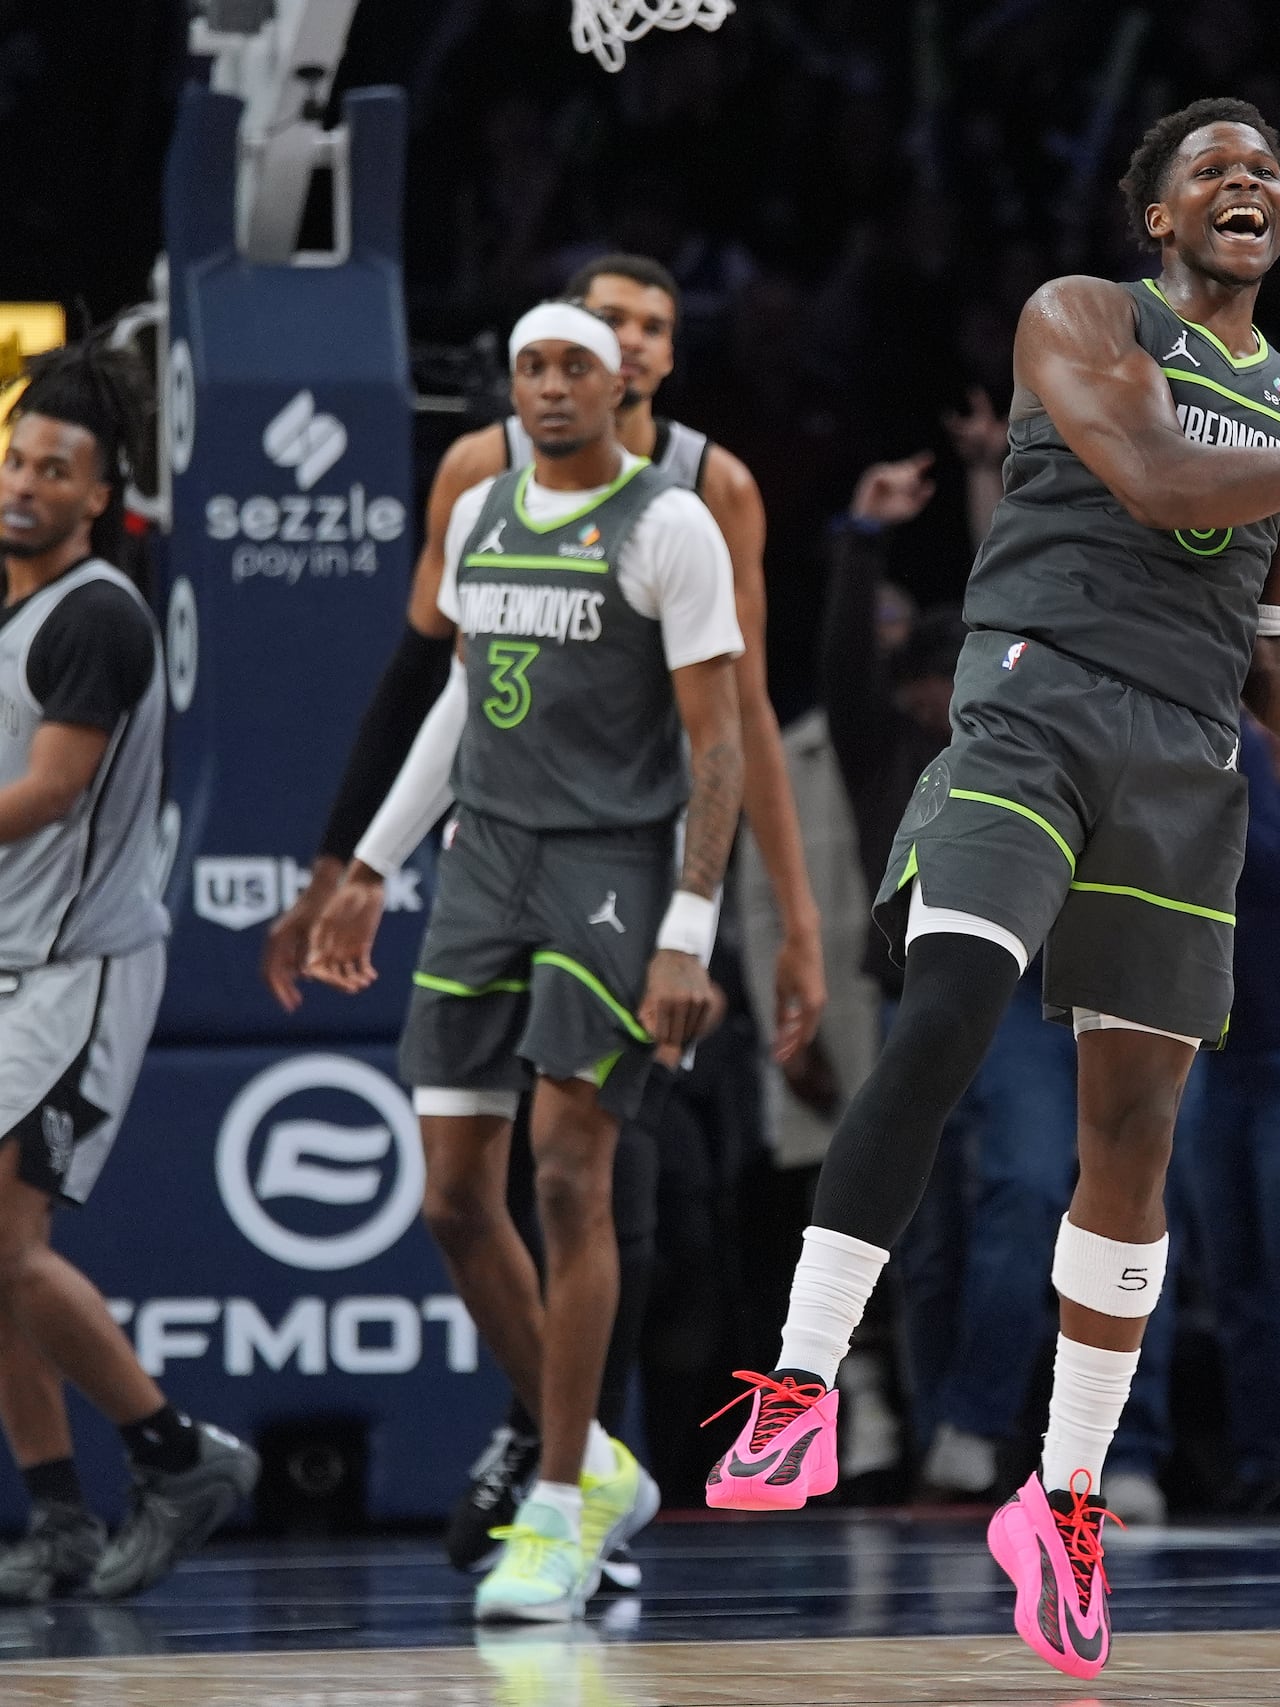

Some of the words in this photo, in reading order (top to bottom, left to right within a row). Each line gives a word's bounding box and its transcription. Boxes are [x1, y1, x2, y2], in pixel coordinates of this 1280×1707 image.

[205, 483, 406, 542] sezzle
[231, 543, 308, 585] pay
[352, 540, 377, 577] 4
[483, 640, 541, 729] 3
[1114, 1267, 1148, 1291] 5
[110, 1295, 478, 1377] FMOT
